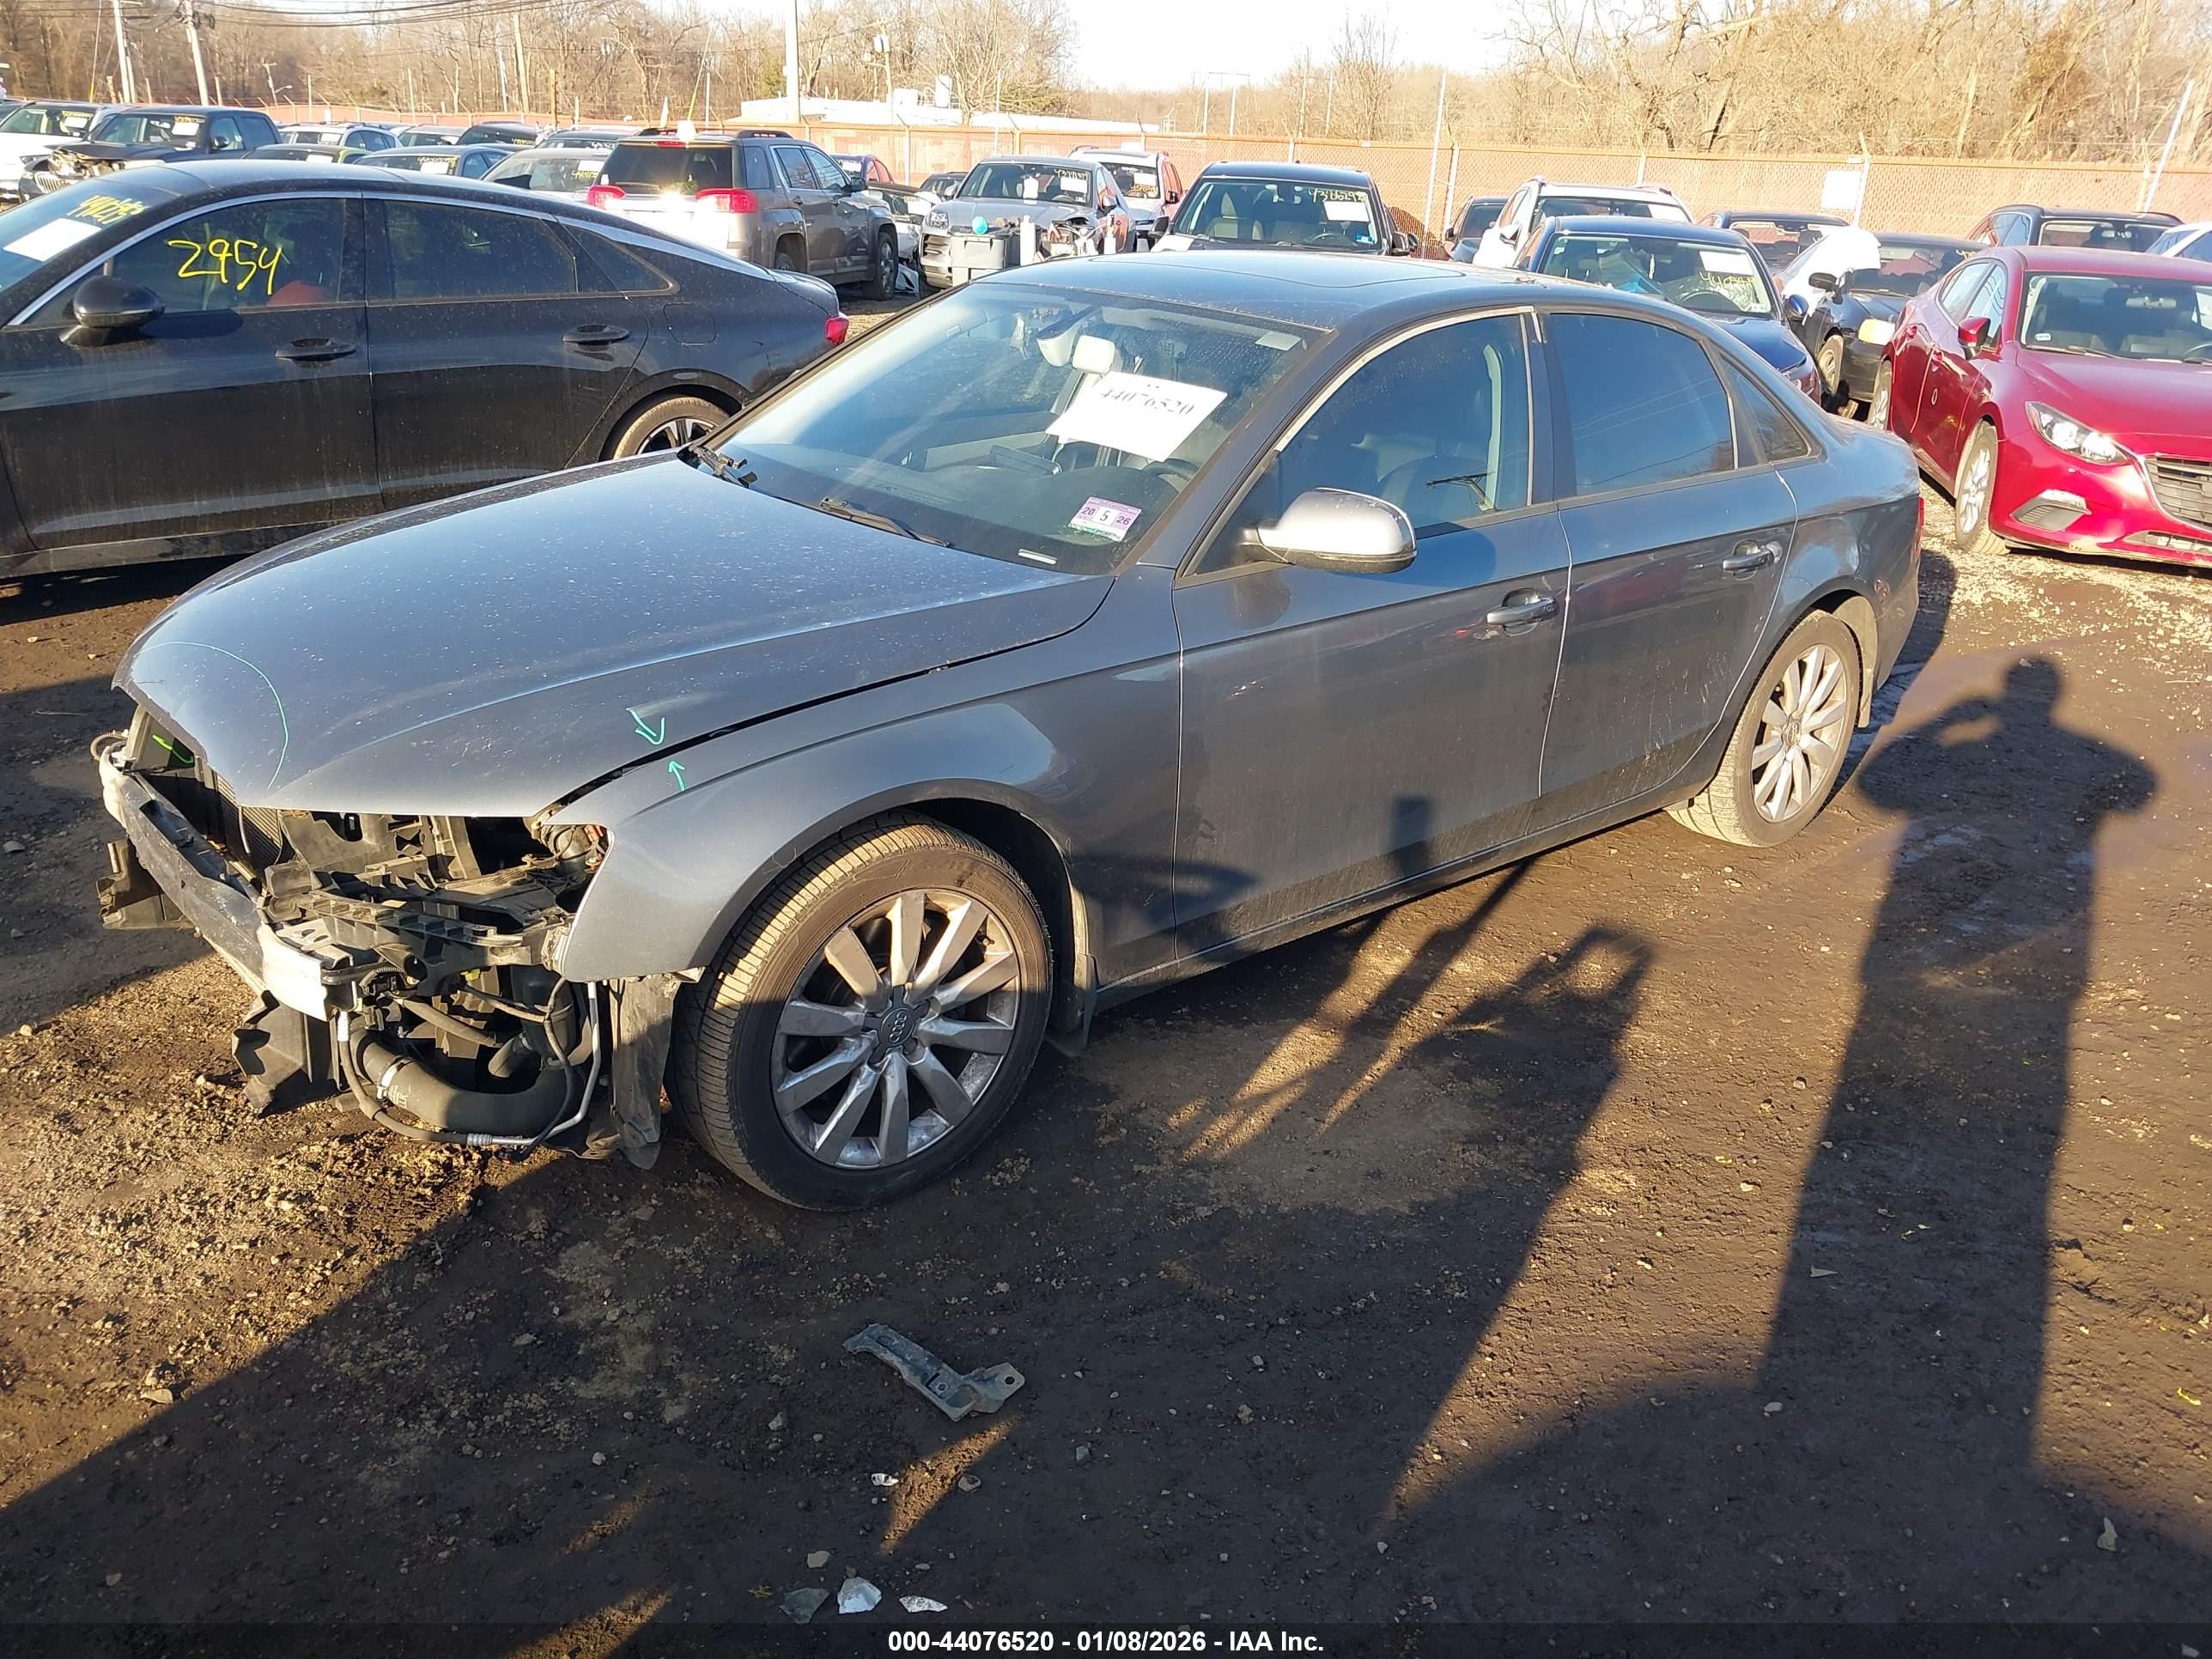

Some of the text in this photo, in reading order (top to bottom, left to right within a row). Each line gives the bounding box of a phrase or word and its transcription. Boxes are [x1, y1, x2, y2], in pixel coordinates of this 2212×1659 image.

[167, 239, 283, 295] 2954
[1081, 507, 1097, 517] 20
[1099, 510, 1112, 522] 5
[1116, 515, 1132, 526] 26
